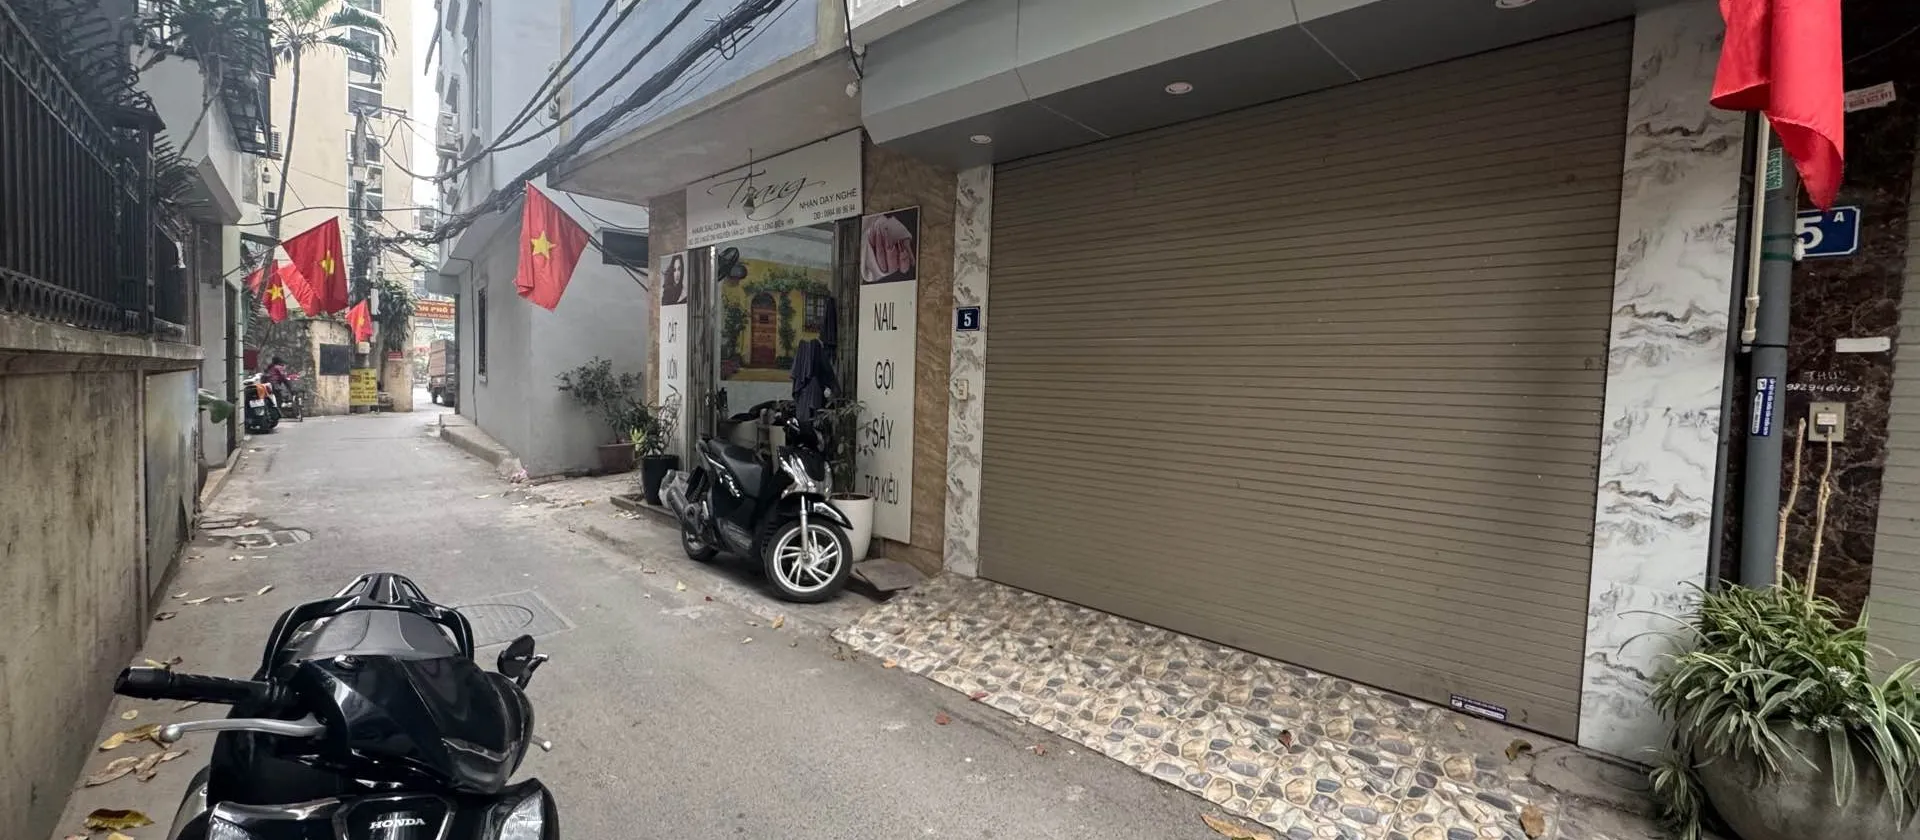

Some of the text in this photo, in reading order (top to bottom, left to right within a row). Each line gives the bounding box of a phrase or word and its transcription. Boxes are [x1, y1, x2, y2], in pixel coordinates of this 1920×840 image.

[1795, 211, 1845, 250] 5 A
[873, 302, 897, 331] NAIL
[963, 312, 972, 328] 5
[874, 359, 895, 395] GỘI
[369, 818, 426, 830] HONDA
